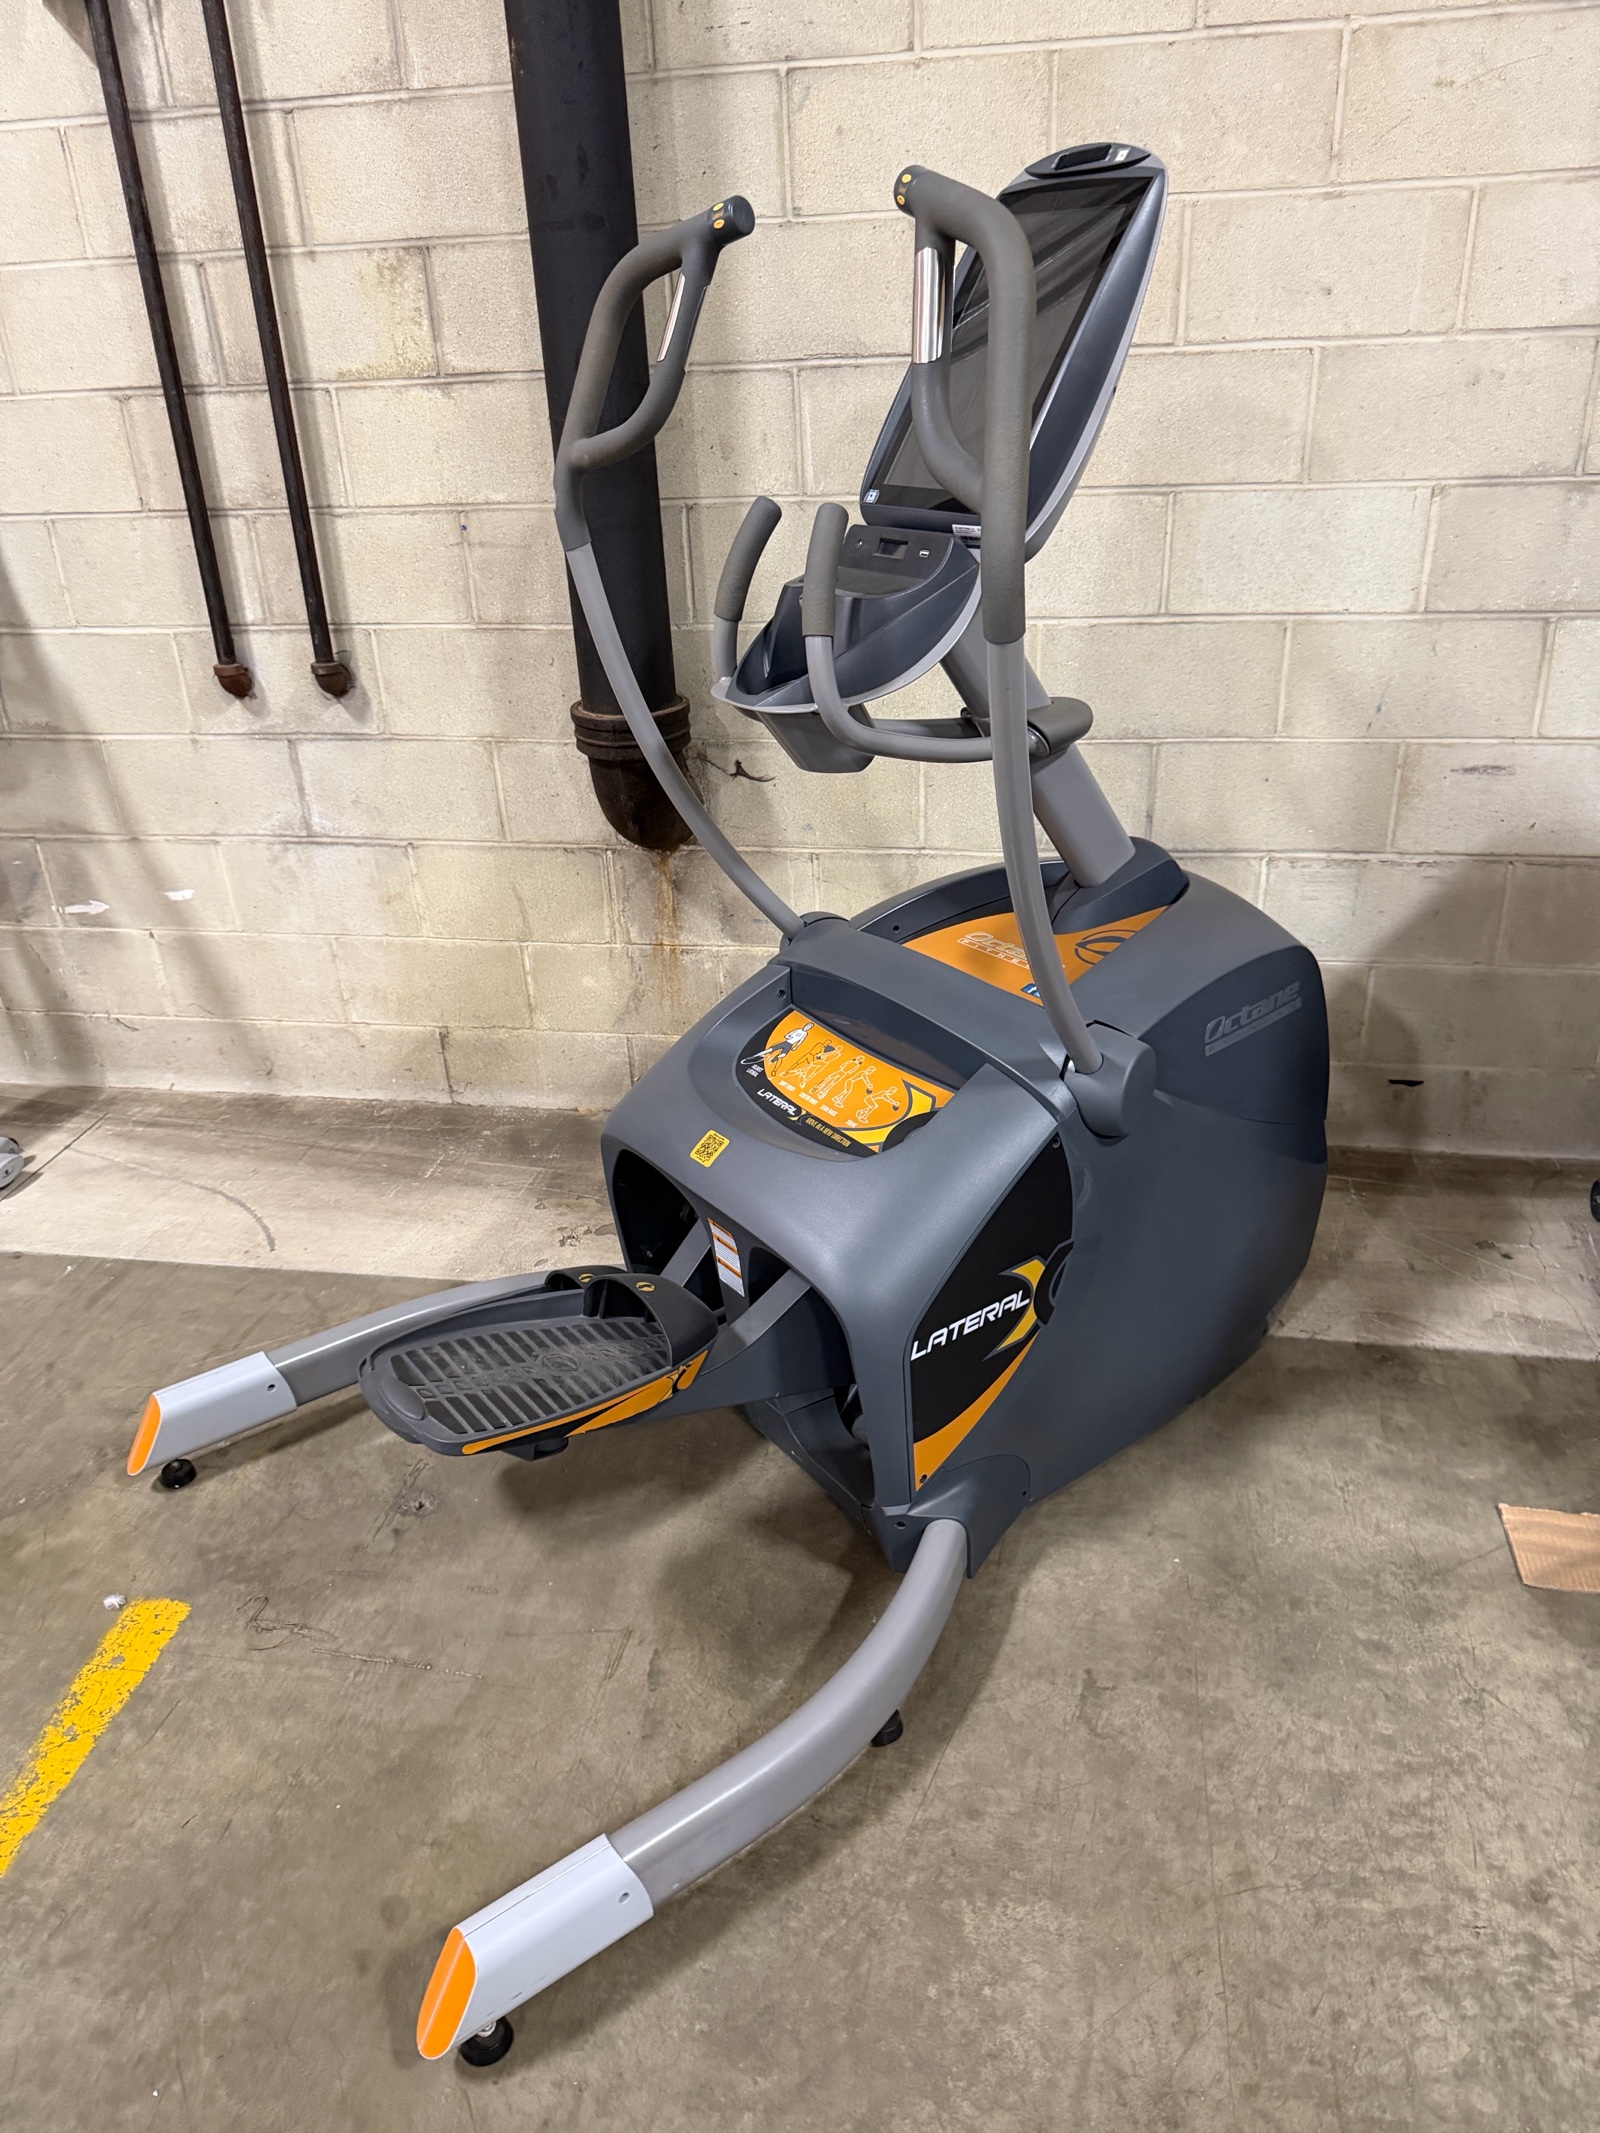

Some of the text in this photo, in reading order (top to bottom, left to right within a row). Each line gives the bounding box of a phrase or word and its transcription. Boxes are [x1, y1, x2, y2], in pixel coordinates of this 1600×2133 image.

[1204, 981, 1300, 1044] Octane
[757, 1088, 798, 1115] LATERAL
[910, 1289, 1031, 1361] LATERAL
